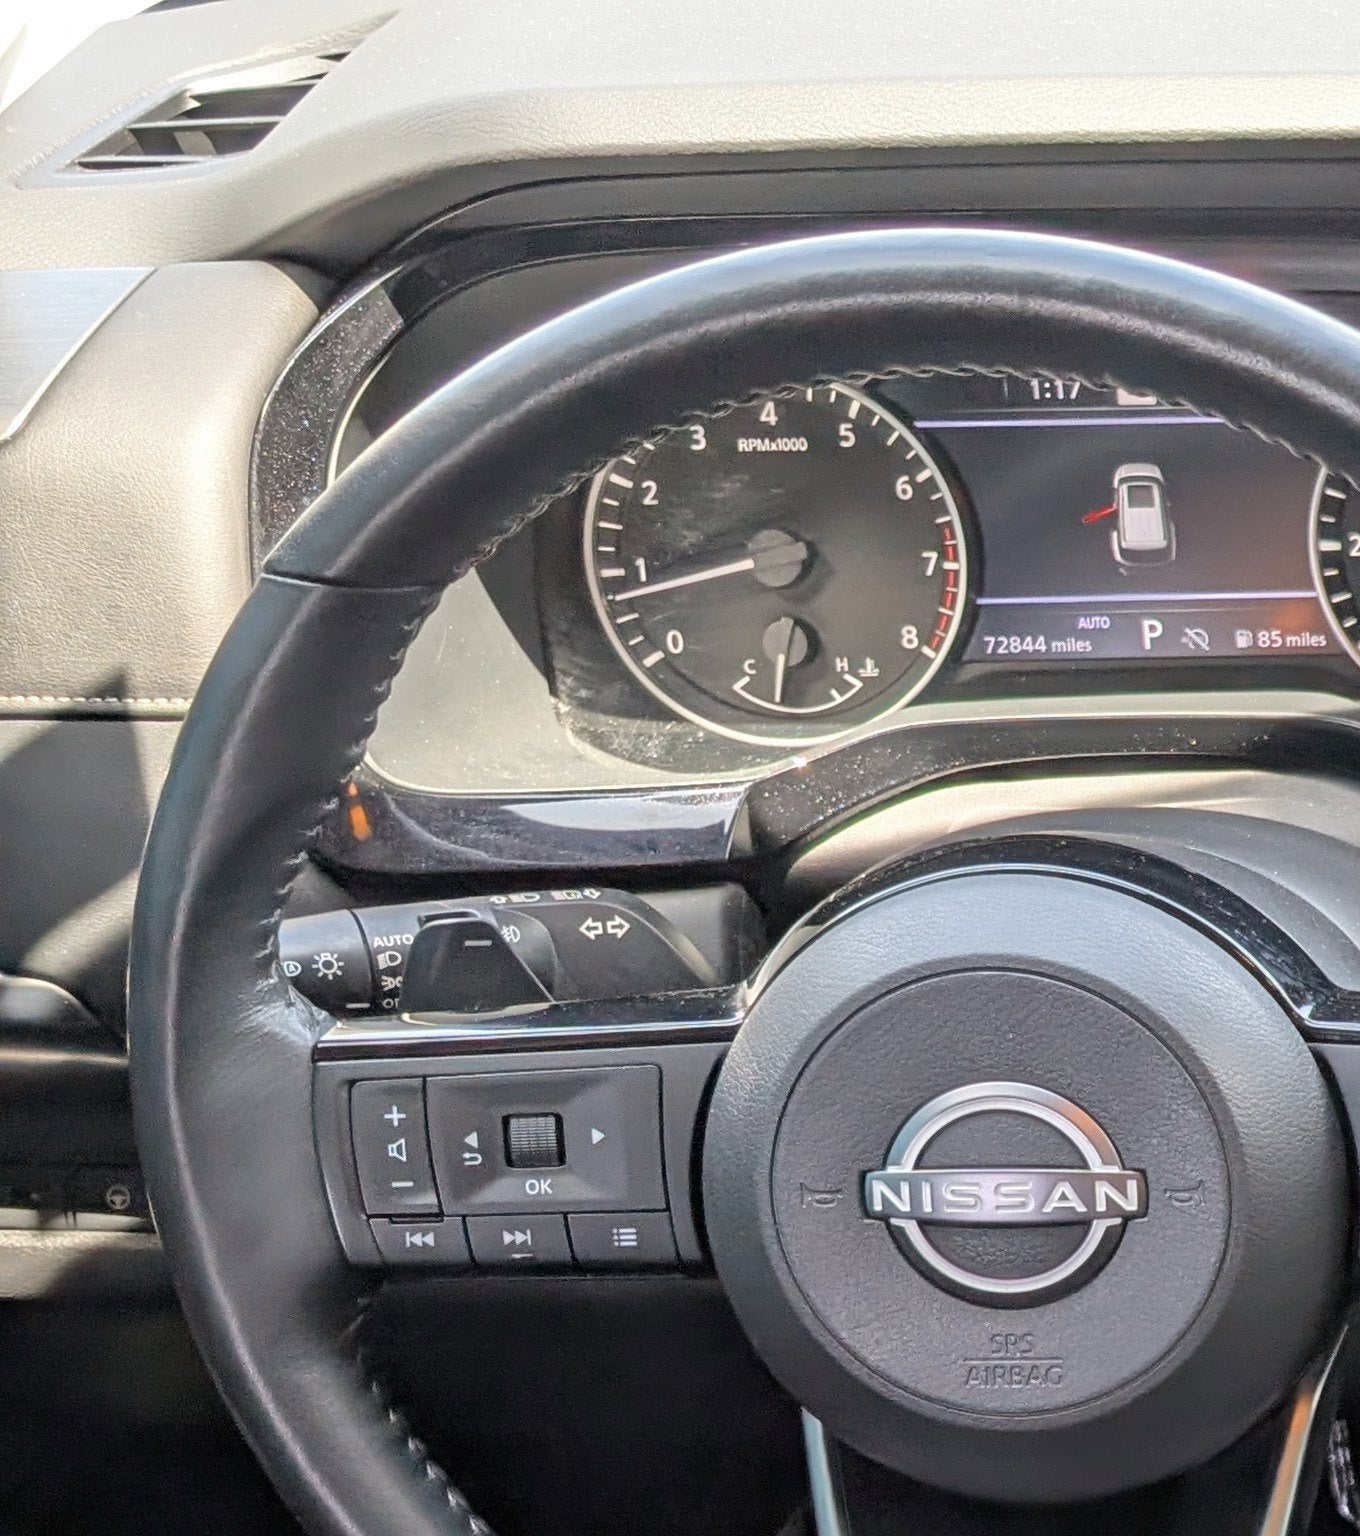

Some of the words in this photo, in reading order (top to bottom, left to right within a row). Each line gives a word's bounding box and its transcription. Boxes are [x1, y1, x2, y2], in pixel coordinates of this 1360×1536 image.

[759, 402, 778, 427] 4
[690, 426, 706, 451] 3
[737, 437, 808, 453] RPMx1000
[839, 423, 856, 448] 5
[642, 482, 659, 506] 2
[895, 475, 913, 501] 6
[635, 557, 647, 581] 1
[921, 551, 938, 576] 7
[1078, 617, 1110, 629] AUTO
[1143, 620, 1162, 649] P
[666, 630, 684, 654] 0
[900, 625, 919, 649] 8
[984, 636, 1047, 654] 72844
[1051, 638, 1092, 653] miles
[1257, 631, 1283, 648] 85
[1286, 632, 1327, 648] miles
[743, 659, 756, 674] C
[835, 657, 849, 672] H
[373, 933, 415, 948] AUTO
[525, 1179, 554, 1196] OK
[872, 1179, 1139, 1213] NISSAN
[964, 1364, 1064, 1389] AIRBAG
